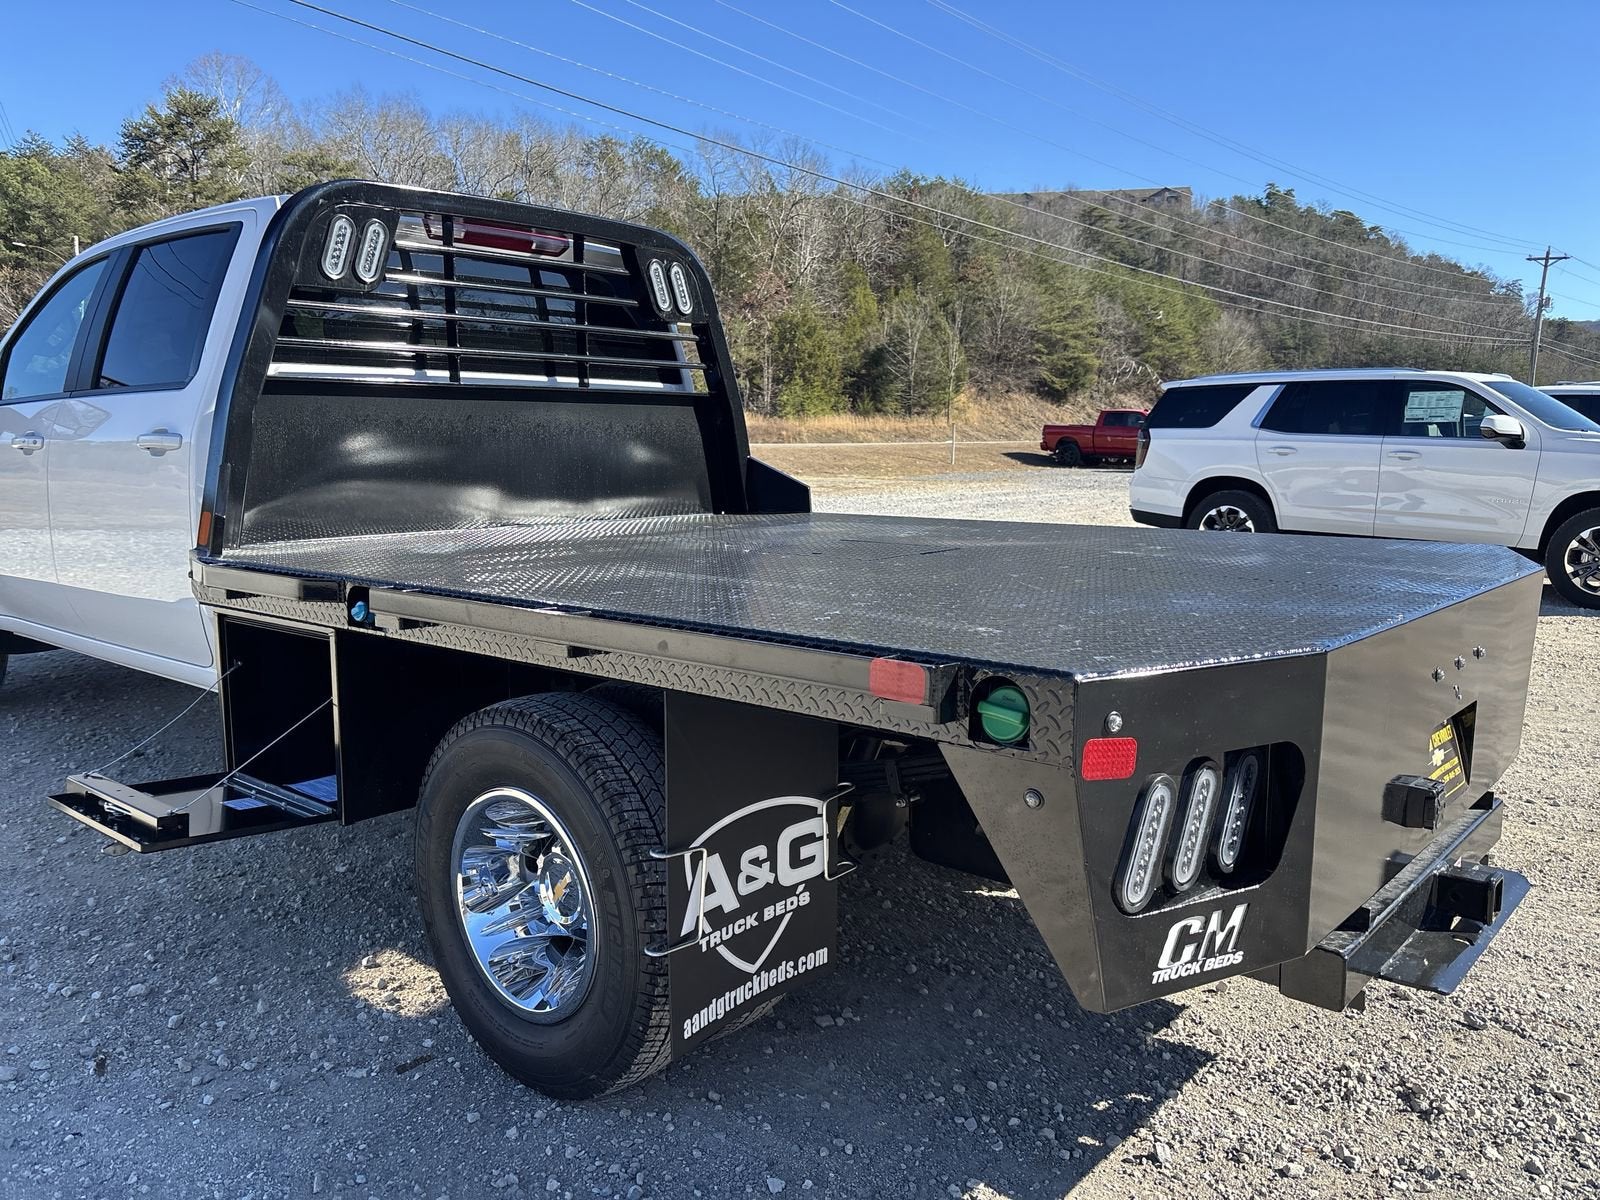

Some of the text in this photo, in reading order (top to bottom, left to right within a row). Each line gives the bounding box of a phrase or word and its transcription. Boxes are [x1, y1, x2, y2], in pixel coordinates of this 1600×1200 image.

[680, 816, 829, 937] A&G
[699, 890, 811, 952] TRUCK BEDS
[1157, 903, 1250, 969] CM
[683, 946, 829, 1040] aandgtruckbeds.com
[1151, 950, 1245, 985] TRUCK BEDS
